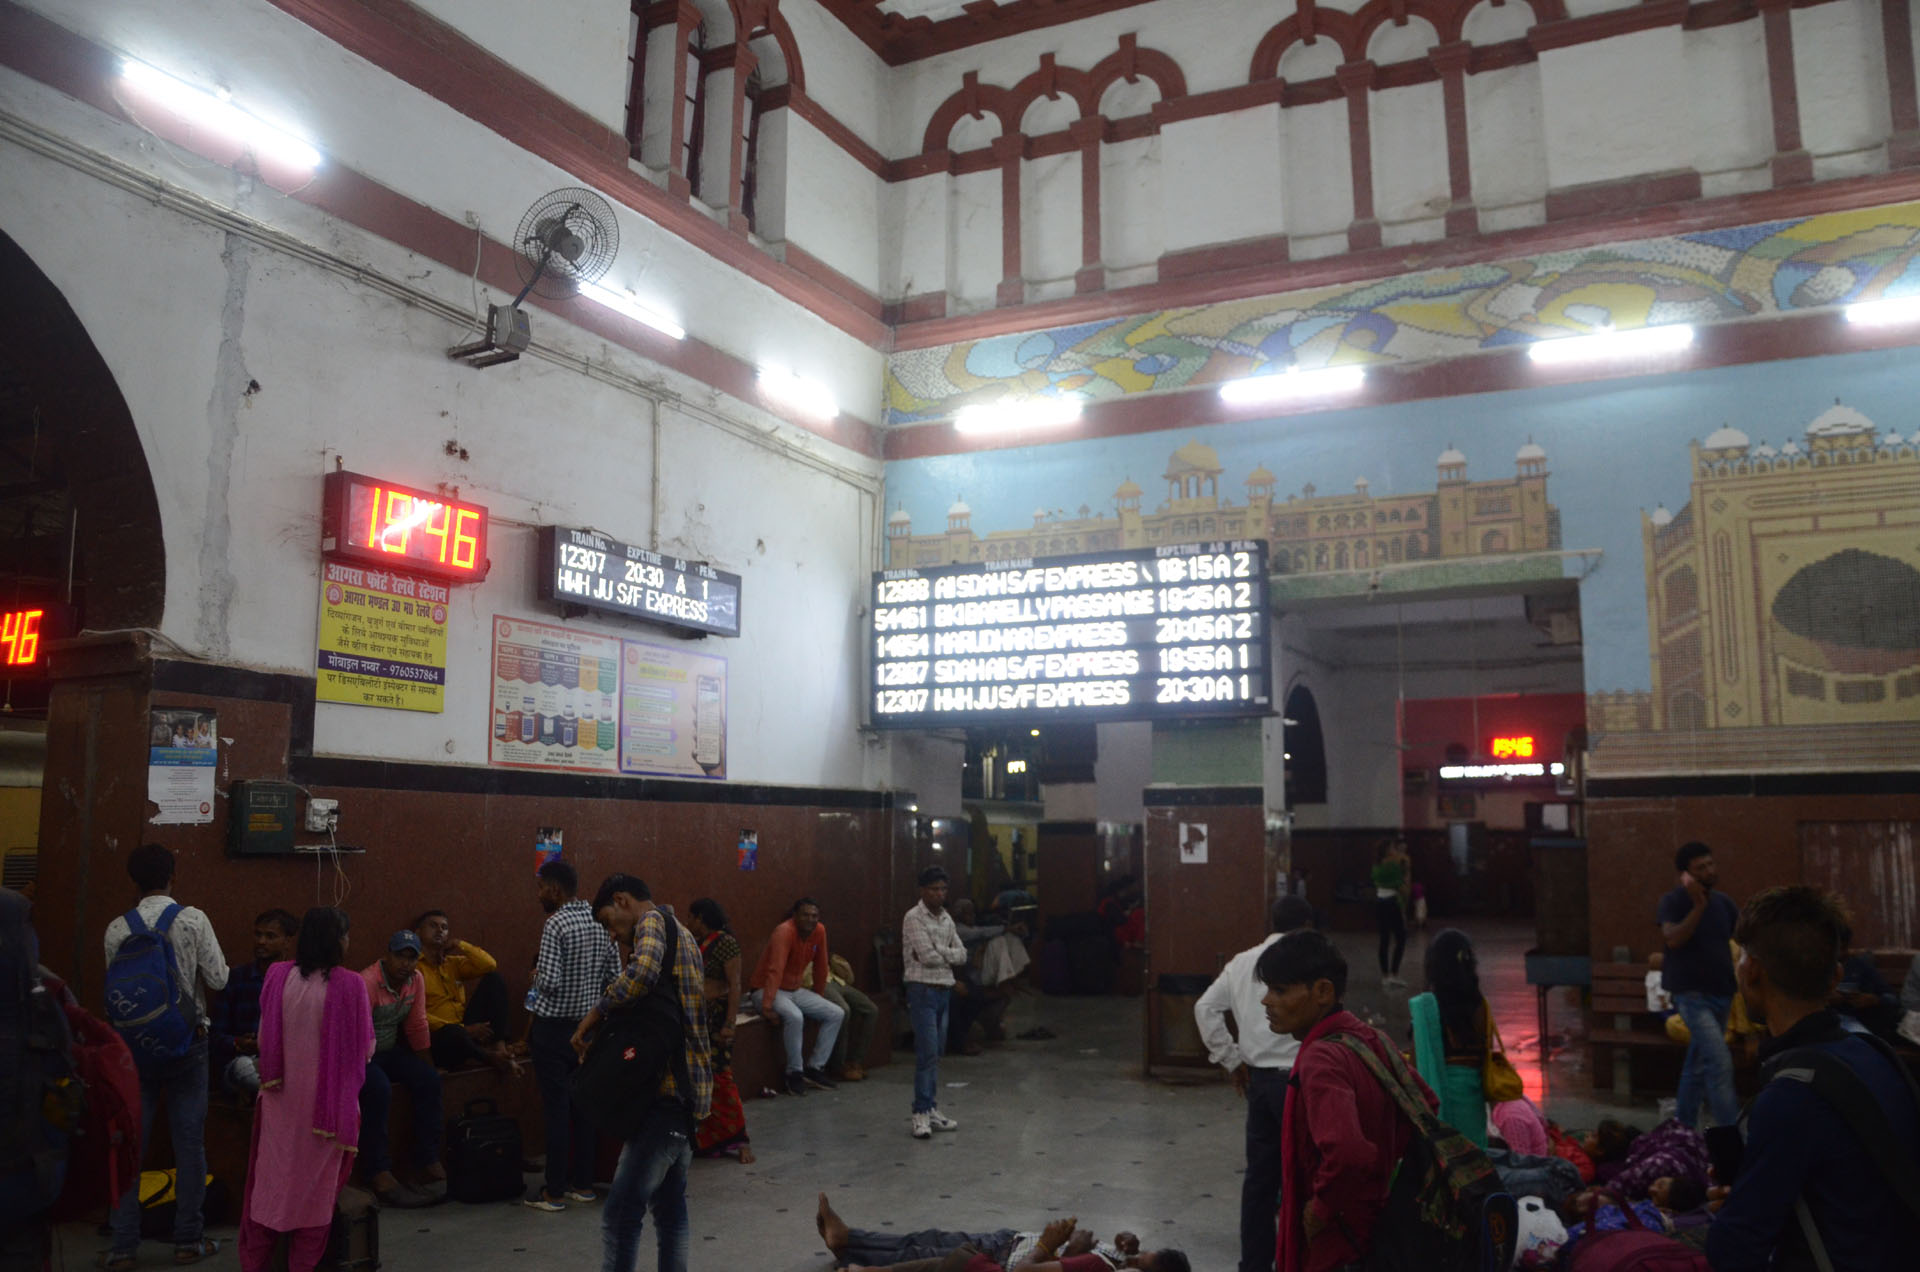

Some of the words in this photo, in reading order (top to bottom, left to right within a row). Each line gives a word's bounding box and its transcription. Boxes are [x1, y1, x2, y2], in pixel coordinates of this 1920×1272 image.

[571, 530, 594, 547] TRAIN
[595, 537, 607, 551] No.
[328, 564, 363, 585] आगरा
[366, 570, 389, 591] फोर्ट
[391, 573, 416, 596] रेलवे
[419, 580, 447, 602] स्टेशन
[560, 543, 606, 574] 12307
[625, 561, 664, 588] 20:30
[675, 574, 686, 594] A
[702, 580, 708, 600] 1
[877, 579, 929, 603] 12988
[1007, 569, 1044, 594] S/F
[1045, 561, 1137, 591] EXPRESS
[1213, 554, 1231, 578] A
[1234, 552, 1250, 577] 2
[884, 569, 906, 580] TRAIN
[985, 559, 1010, 571] TRAIN
[1011, 558, 1034, 569] NAME
[344, 590, 365, 606] आगरा
[368, 595, 389, 611] मण्डल
[416, 601, 431, 618] रेलवे
[558, 567, 590, 596] HWH
[594, 576, 613, 600] JU
[616, 583, 643, 607] S/F
[646, 590, 708, 623] EXPRESS
[874, 606, 927, 631] 54461
[1214, 584, 1232, 609] A
[1234, 582, 1251, 607] 2
[337, 638, 350, 648] जैसे
[342, 625, 349, 635] के
[1034, 621, 1127, 650] EXPRESS
[1156, 616, 1214, 643] 20:05
[1215, 614, 1233, 639] A
[1235, 613, 1251, 638] 2
[328, 652, 359, 672] मोबाइल
[360, 660, 381, 673] नम्बर
[390, 664, 438, 681] 9760537864
[1008, 655, 1044, 679] S/F
[1045, 650, 1139, 678] EXPRESS
[1159, 646, 1215, 672] 19:55
[1215, 644, 1233, 670] A
[1238, 644, 1248, 669] 1
[326, 673, 336, 682] पर
[410, 682, 417, 693] से
[363, 693, 373, 701] कर
[376, 694, 394, 703] सकते
[876, 689, 929, 713] 12307
[934, 687, 973, 711] HWH
[974, 686, 998, 709] JU
[998, 684, 1035, 709] S/F
[1036, 680, 1130, 708] EXPRESS
[1156, 676, 1215, 703] 20:30
[1216, 675, 1233, 700] A
[1239, 674, 1249, 699] 1
